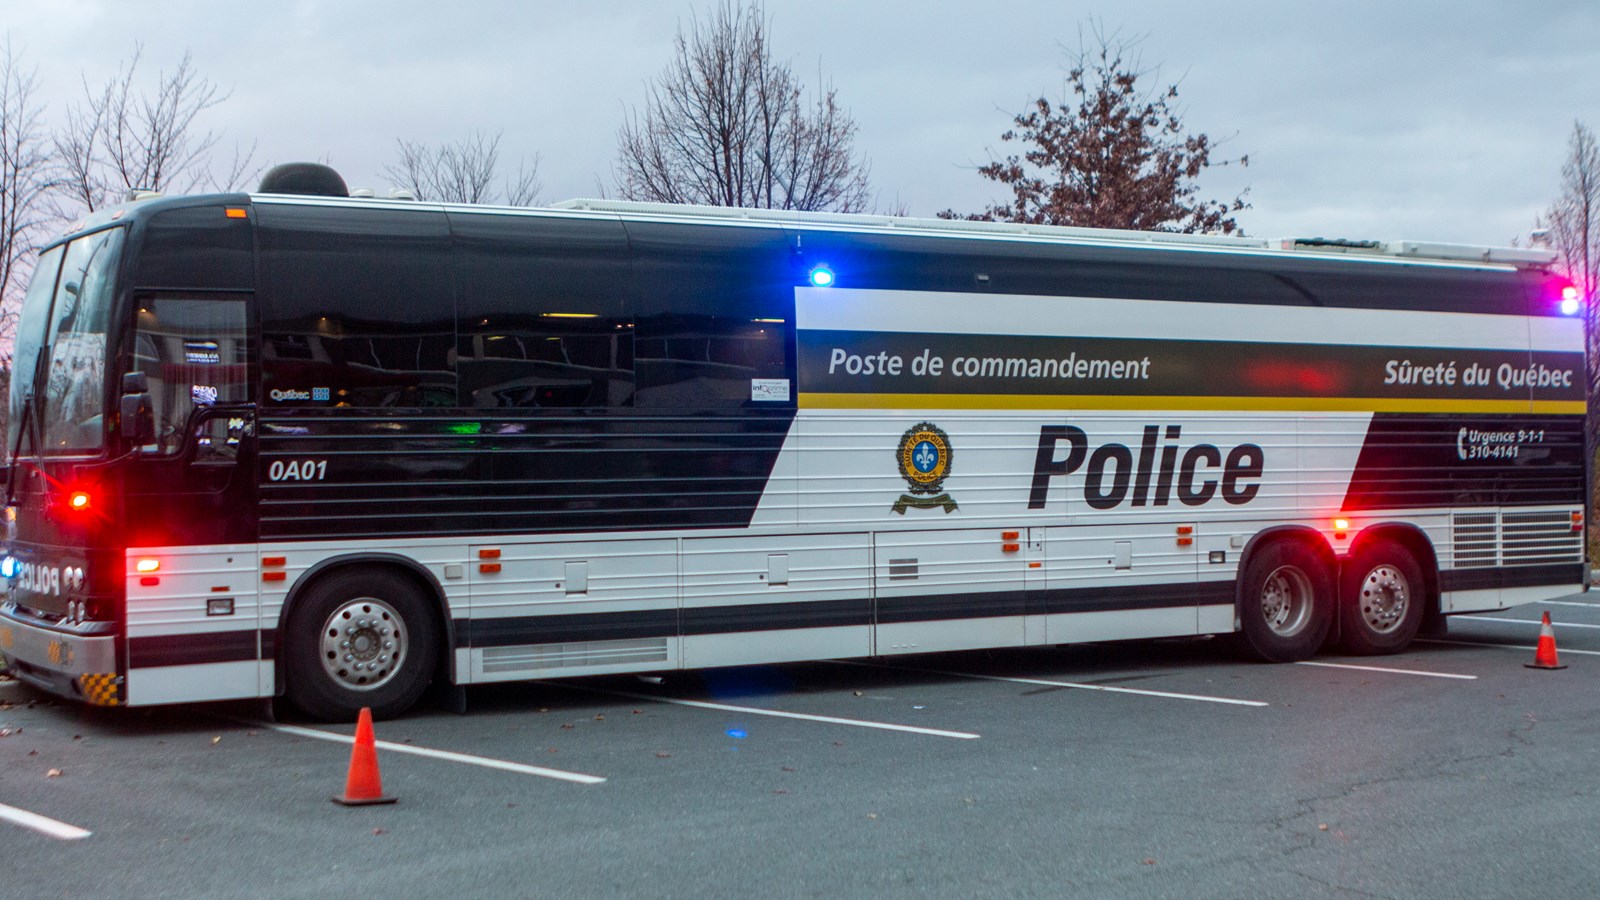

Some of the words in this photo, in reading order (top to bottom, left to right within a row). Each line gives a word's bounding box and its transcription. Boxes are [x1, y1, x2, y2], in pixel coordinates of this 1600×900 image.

[829, 348, 903, 376] Poste
[911, 349, 944, 376] de
[951, 352, 1151, 379] commandement
[1384, 359, 1457, 386] Sûreté
[1463, 362, 1491, 386] du
[1497, 362, 1573, 390] Québec
[270, 388, 310, 401] Québec
[1469, 430, 1515, 445] Urgence
[1517, 429, 1544, 443] 9-1-1
[1468, 445, 1519, 459] 310-4141
[269, 460, 328, 481] 0A01
[914, 470, 939, 481] POLICE
[1028, 425, 1264, 509] Police
